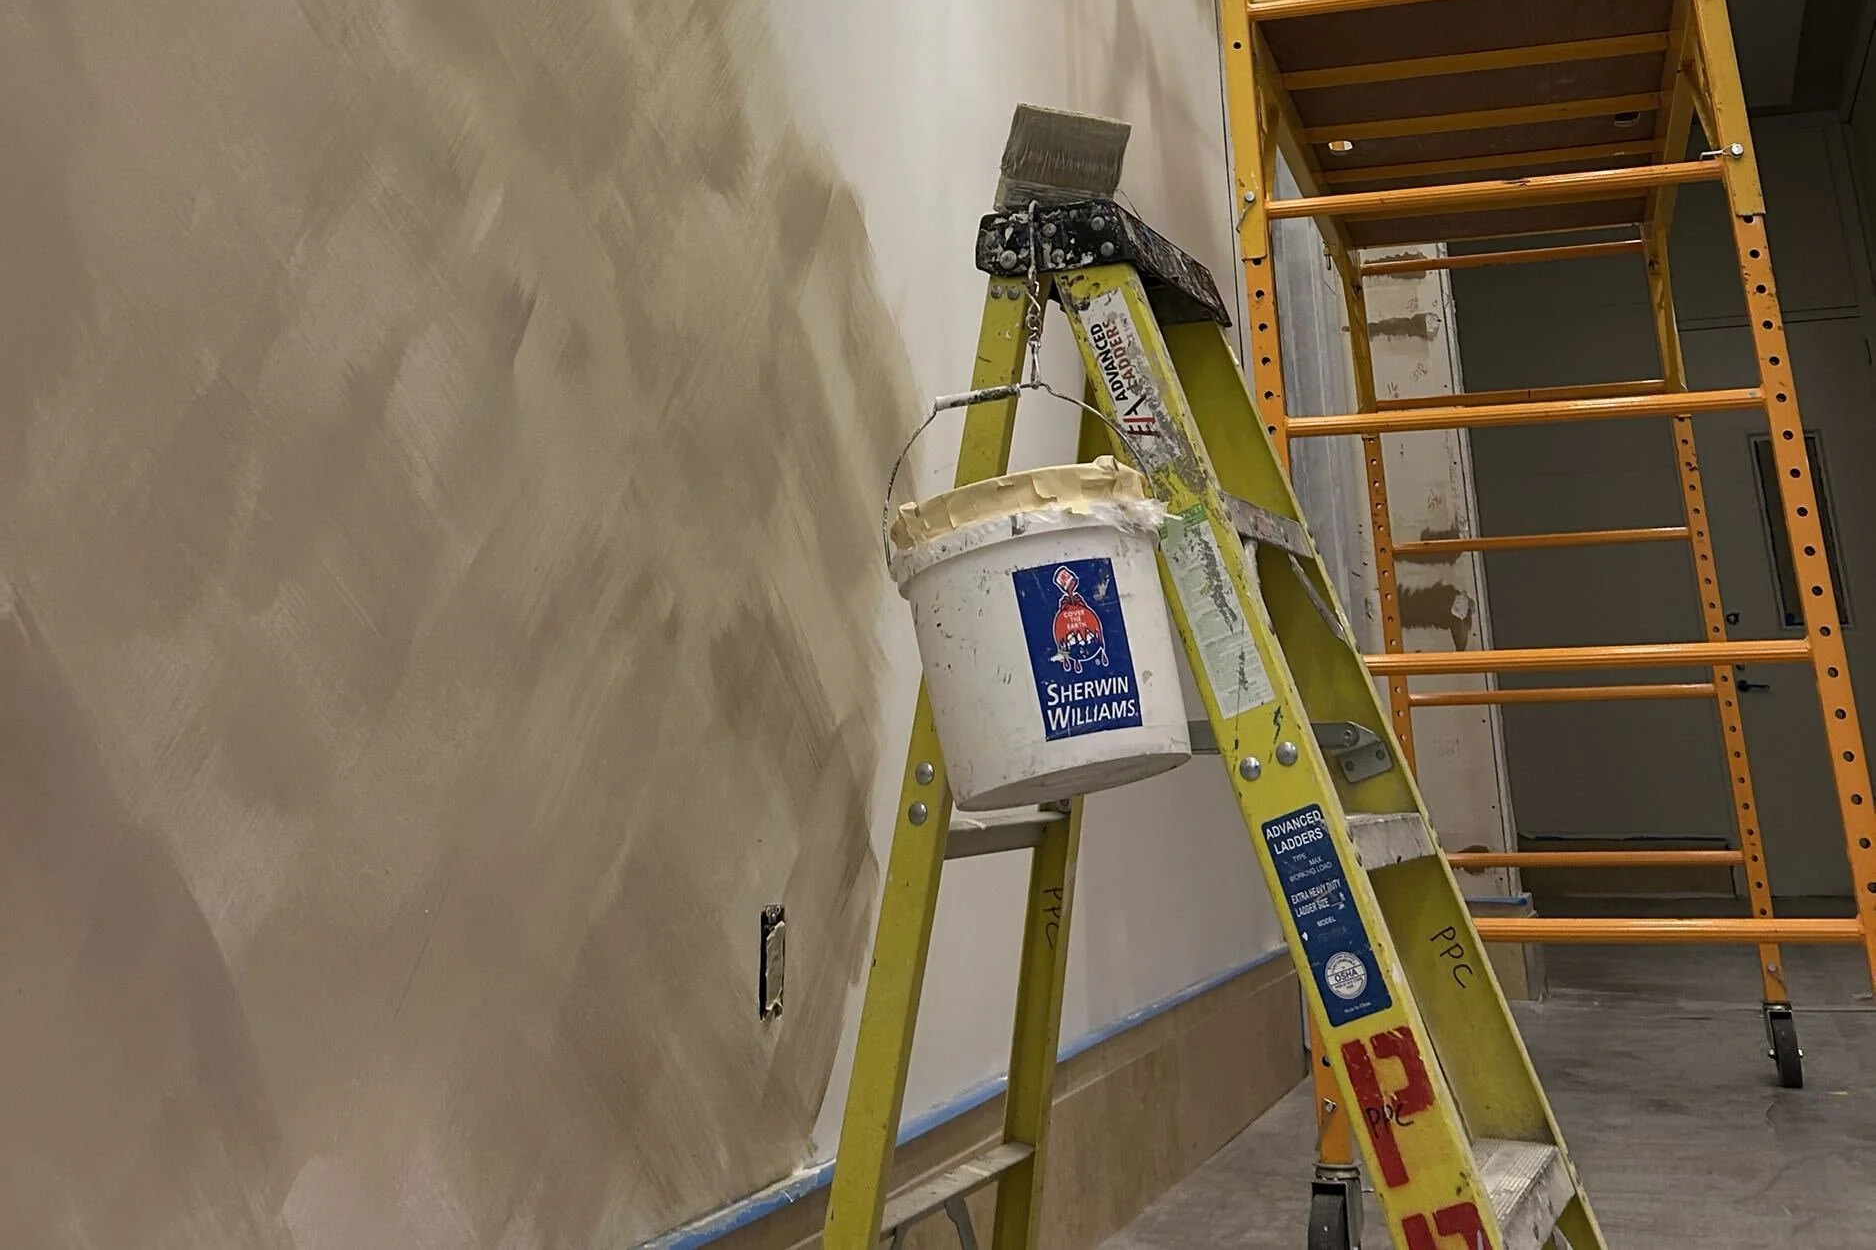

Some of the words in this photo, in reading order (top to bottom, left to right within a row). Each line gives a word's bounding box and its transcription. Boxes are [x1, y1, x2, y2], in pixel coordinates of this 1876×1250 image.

[1090, 323, 1128, 401] ADVANCED
[1063, 610, 1085, 618] COVER
[1047, 676, 1129, 706] SHERWIN
[1047, 700, 1136, 731] WILLIAMS
[1266, 810, 1321, 840] ADVANCED
[1273, 827, 1324, 855] LADDERS
[1292, 852, 1307, 863] TYPE
[1290, 890, 1310, 905] EXTRA
[1308, 883, 1327, 898] HEAVY
[1430, 926, 1473, 989] PPC
[1334, 968, 1359, 982] OSHA
[1366, 1101, 1414, 1139] PPC
